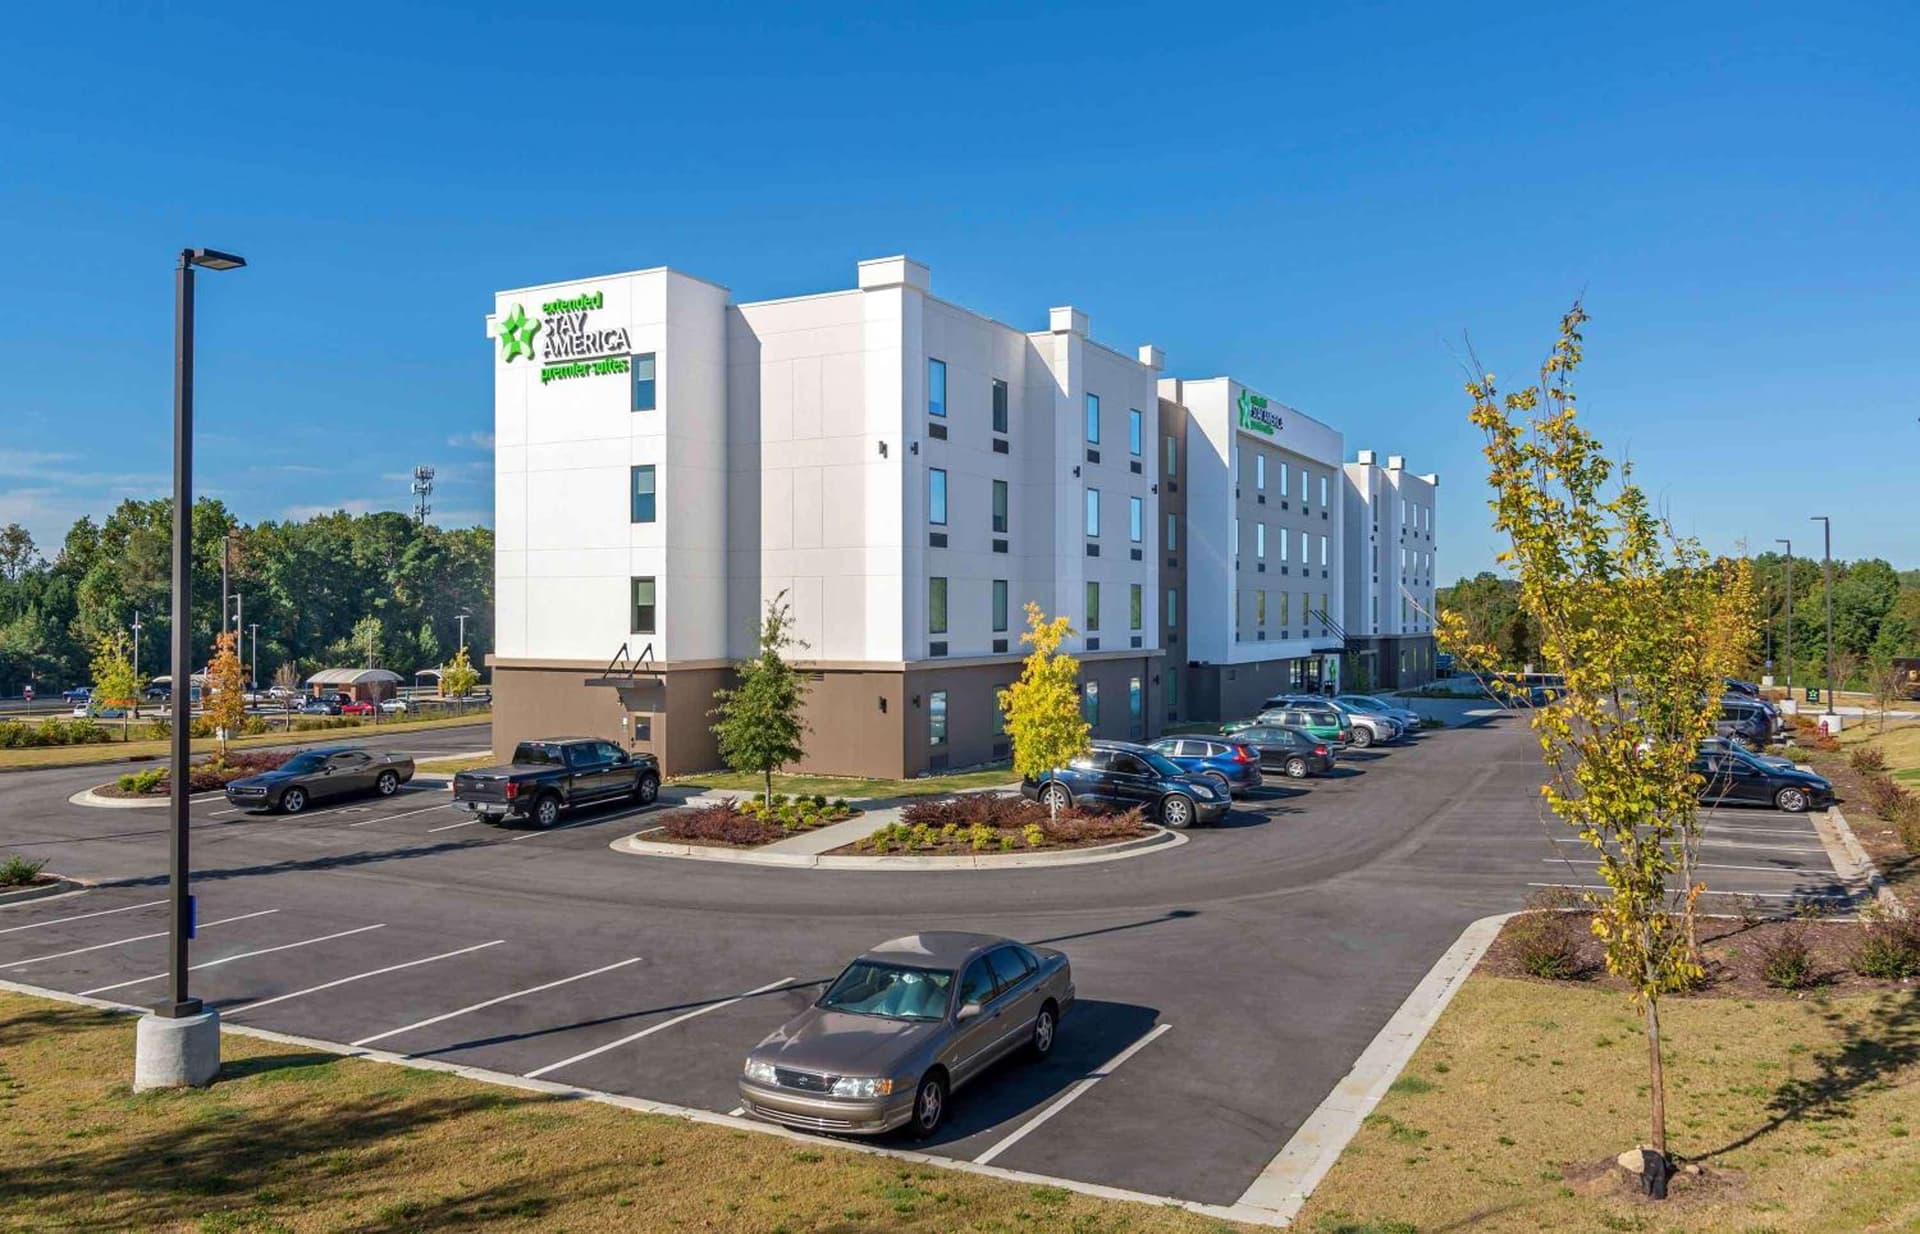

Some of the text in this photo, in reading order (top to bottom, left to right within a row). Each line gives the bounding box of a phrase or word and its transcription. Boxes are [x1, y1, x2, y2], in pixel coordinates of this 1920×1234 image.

[543, 291, 604, 314] extended
[544, 312, 588, 337] STAY
[543, 327, 632, 358] AMERICA
[541, 358, 630, 384] premier suites
